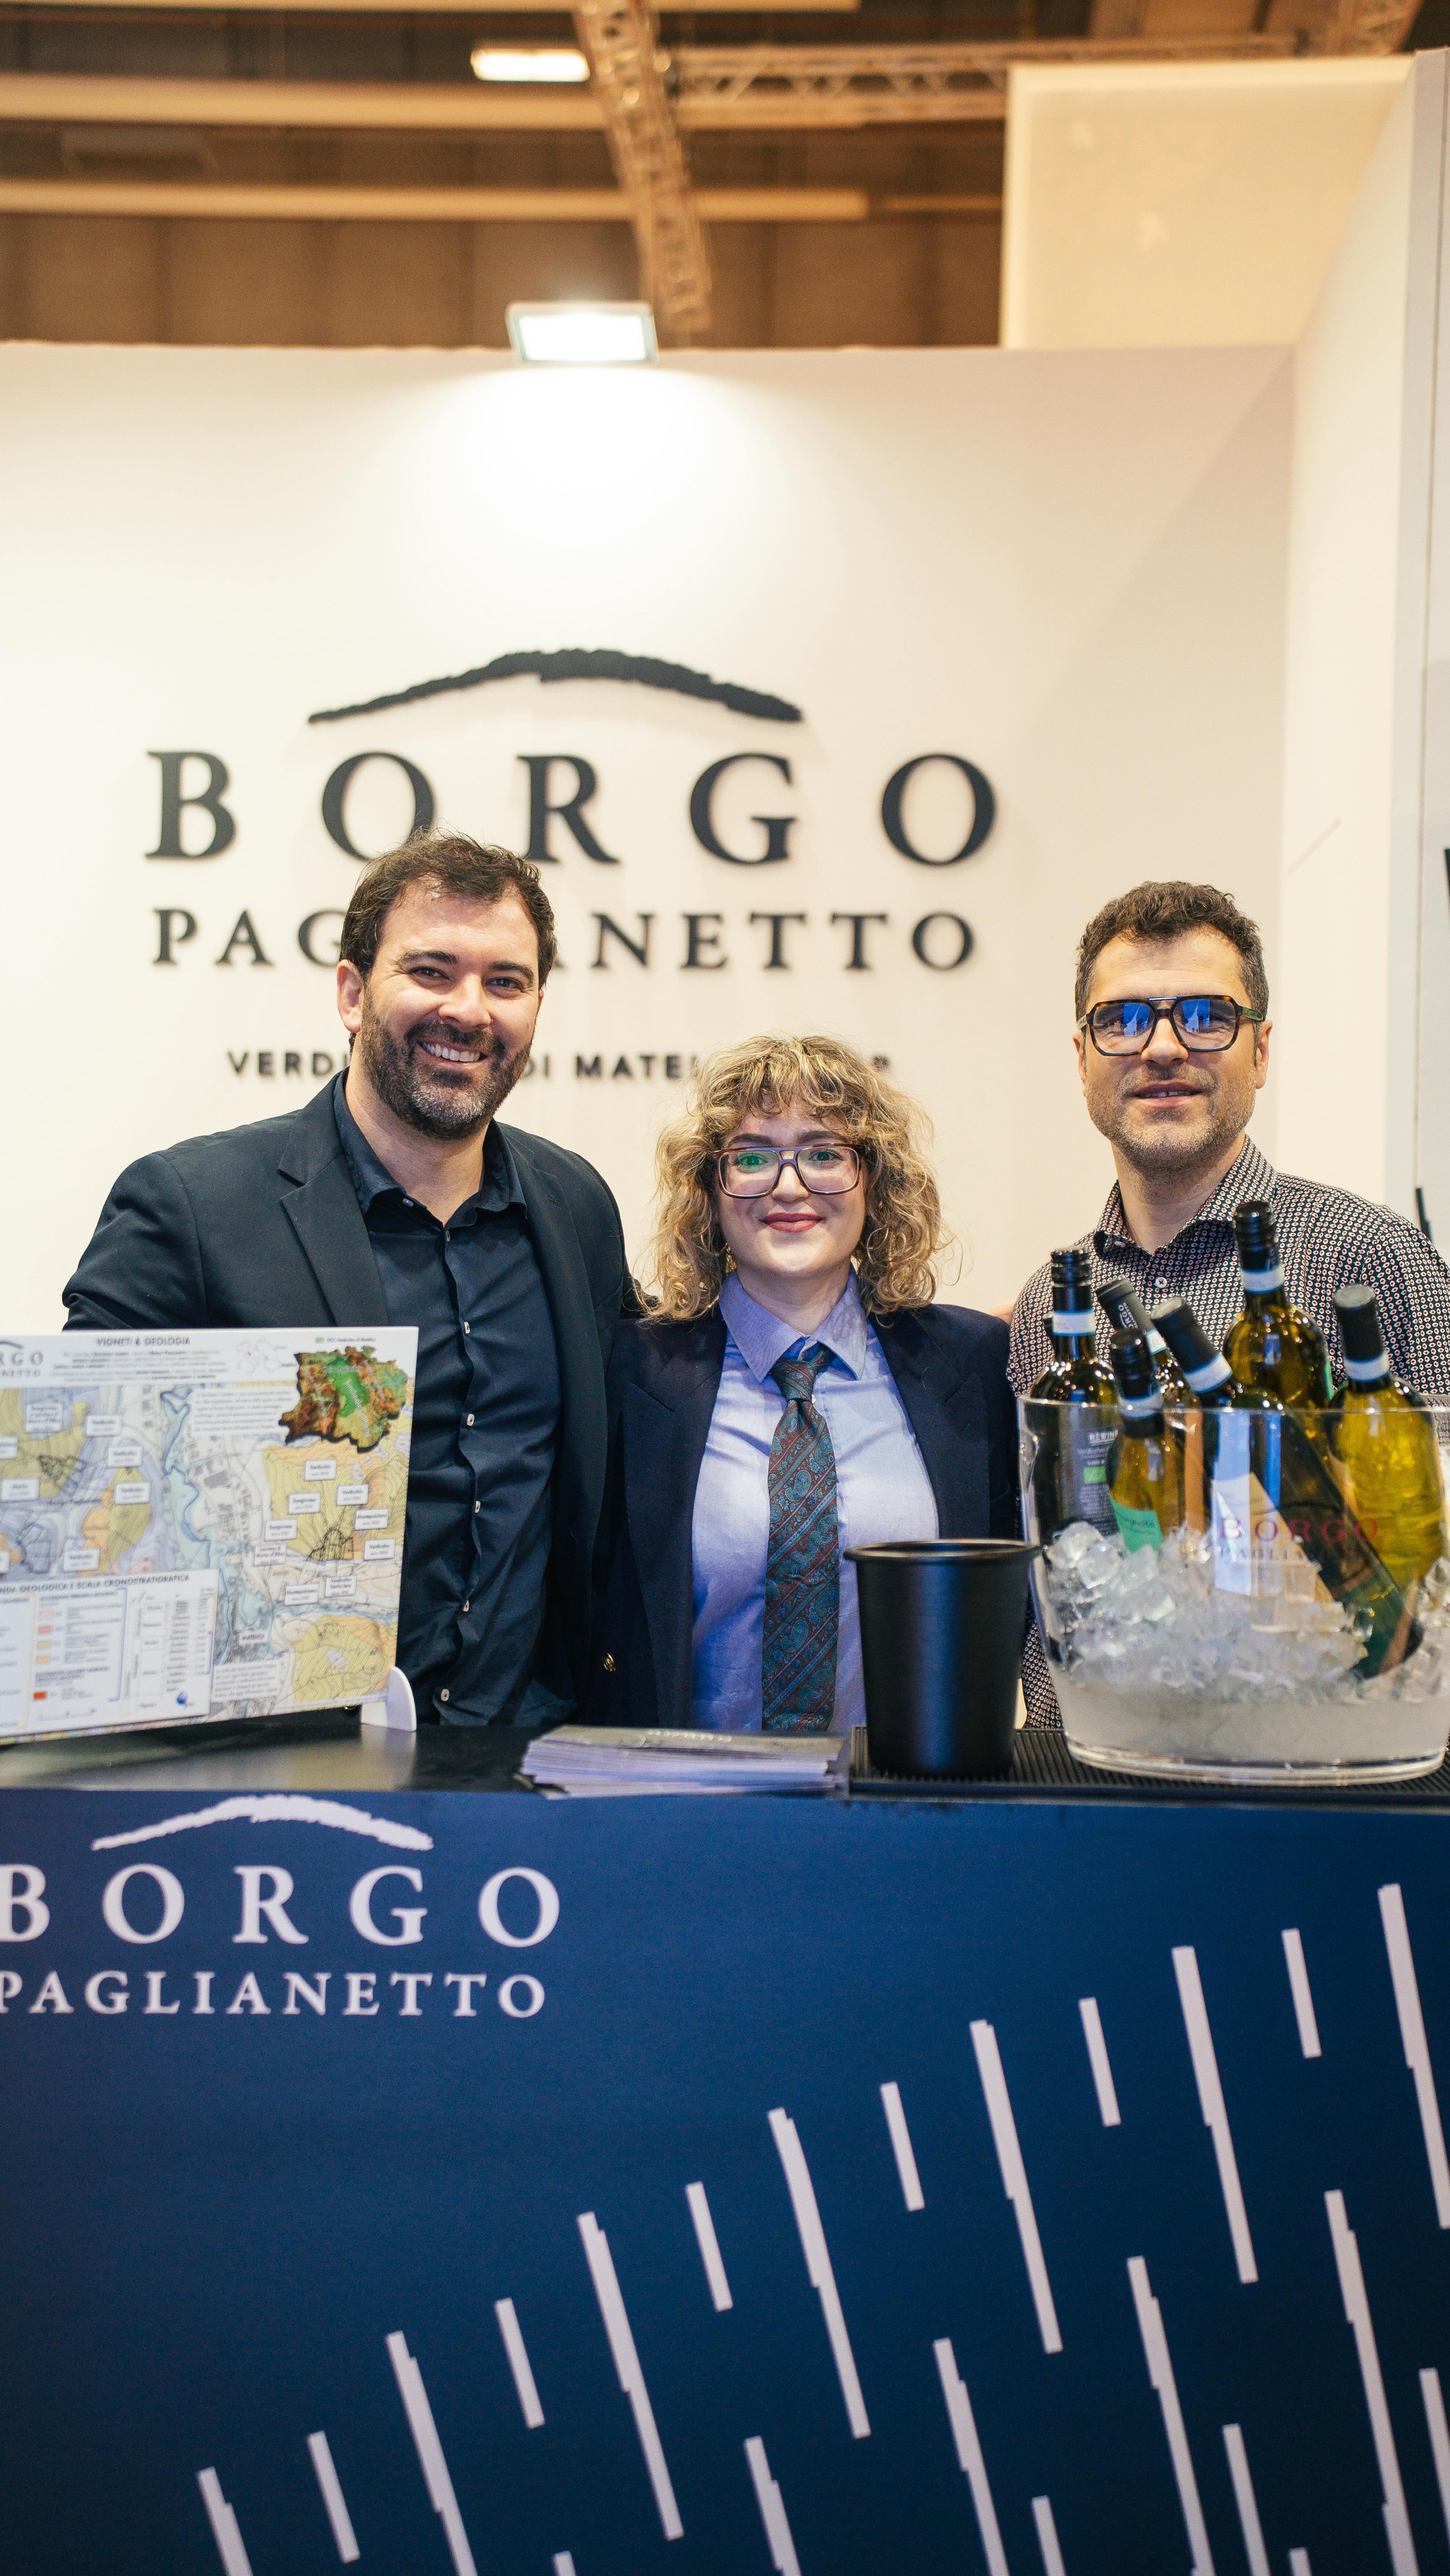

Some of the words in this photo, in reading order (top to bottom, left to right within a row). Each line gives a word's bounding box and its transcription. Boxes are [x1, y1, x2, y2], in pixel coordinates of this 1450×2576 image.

[145, 750, 997, 866] BORGO
[153, 908, 976, 970] PAGNETTO
[227, 1050, 348, 1077] VERDI
[0, 1863, 560, 1948] BORGO
[0, 1970, 546, 2018] PAGLIANETTO
